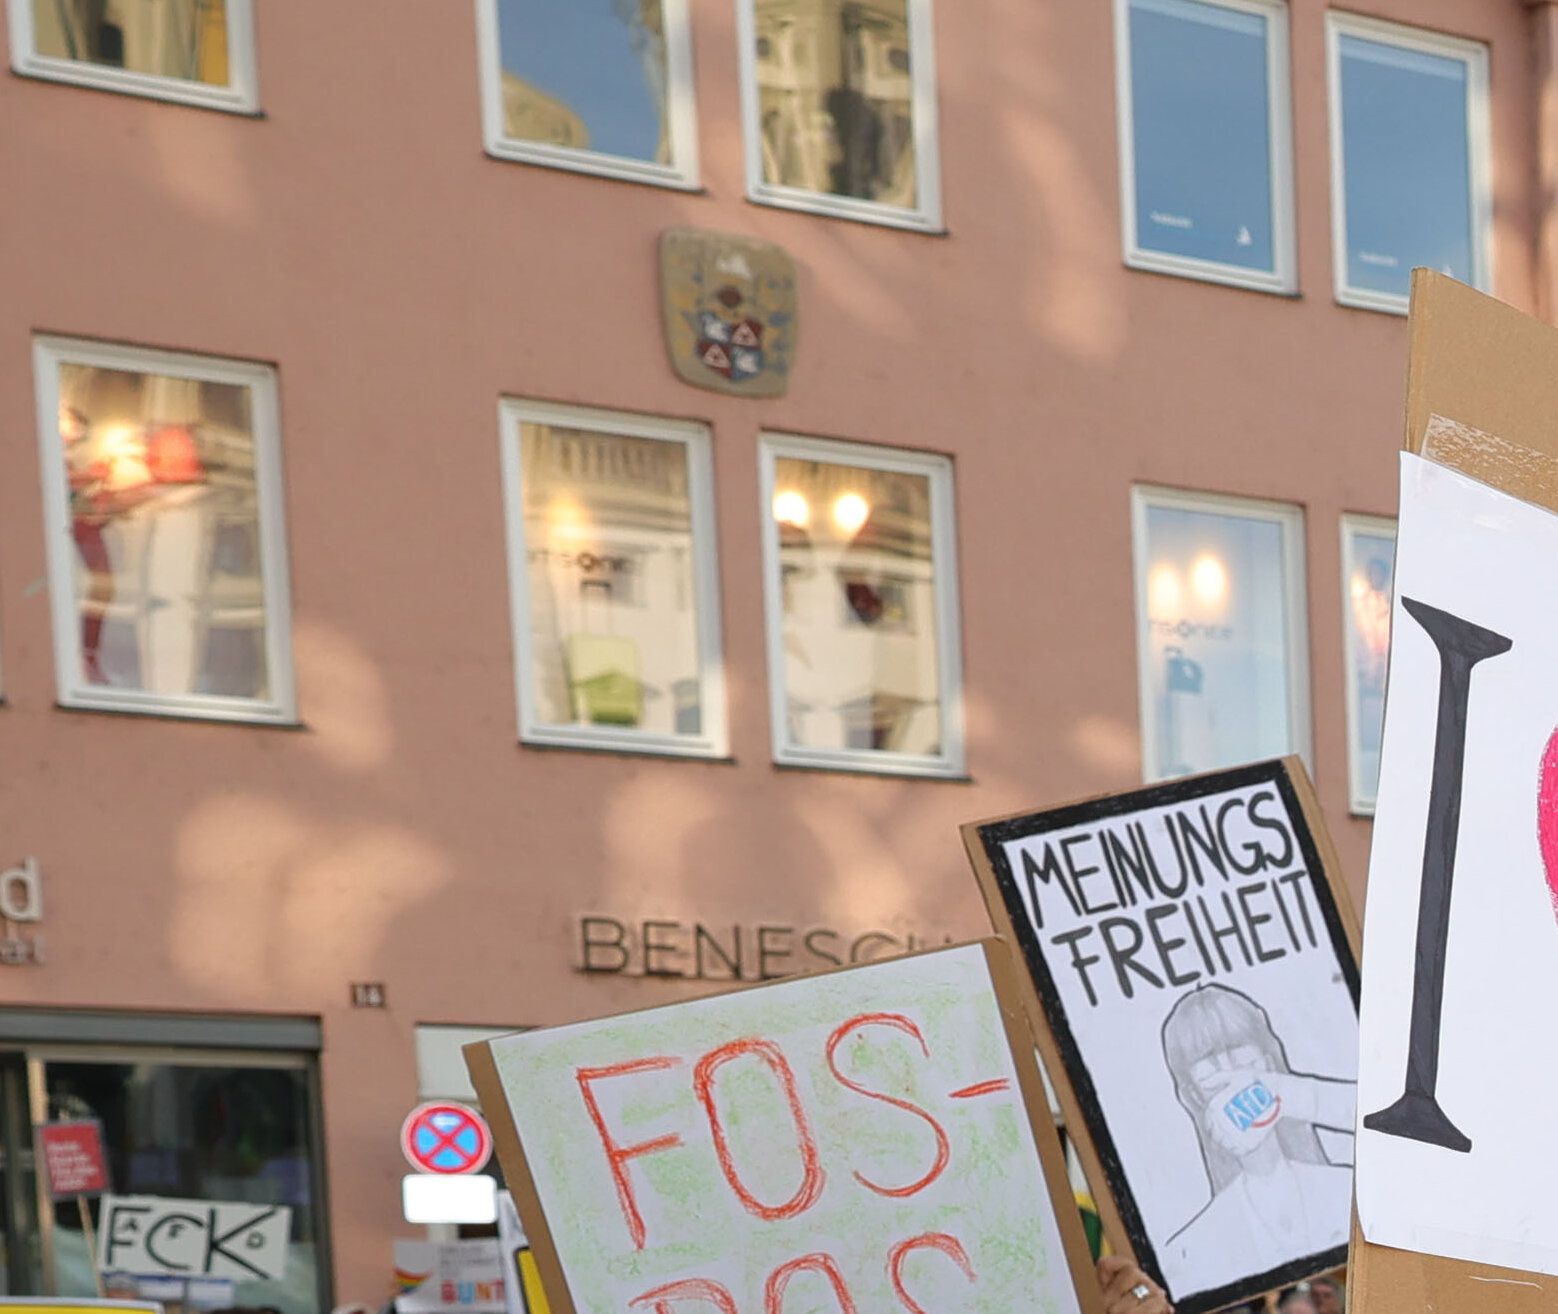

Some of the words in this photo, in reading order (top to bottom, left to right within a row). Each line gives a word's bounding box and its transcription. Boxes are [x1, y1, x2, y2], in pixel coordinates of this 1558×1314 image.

[1021, 791, 1296, 929] MEINUNGS
[1363, 596, 1513, 1152] I
[1052, 870, 1318, 1007] FREIHEIT
[105, 1207, 277, 1280] FCK
